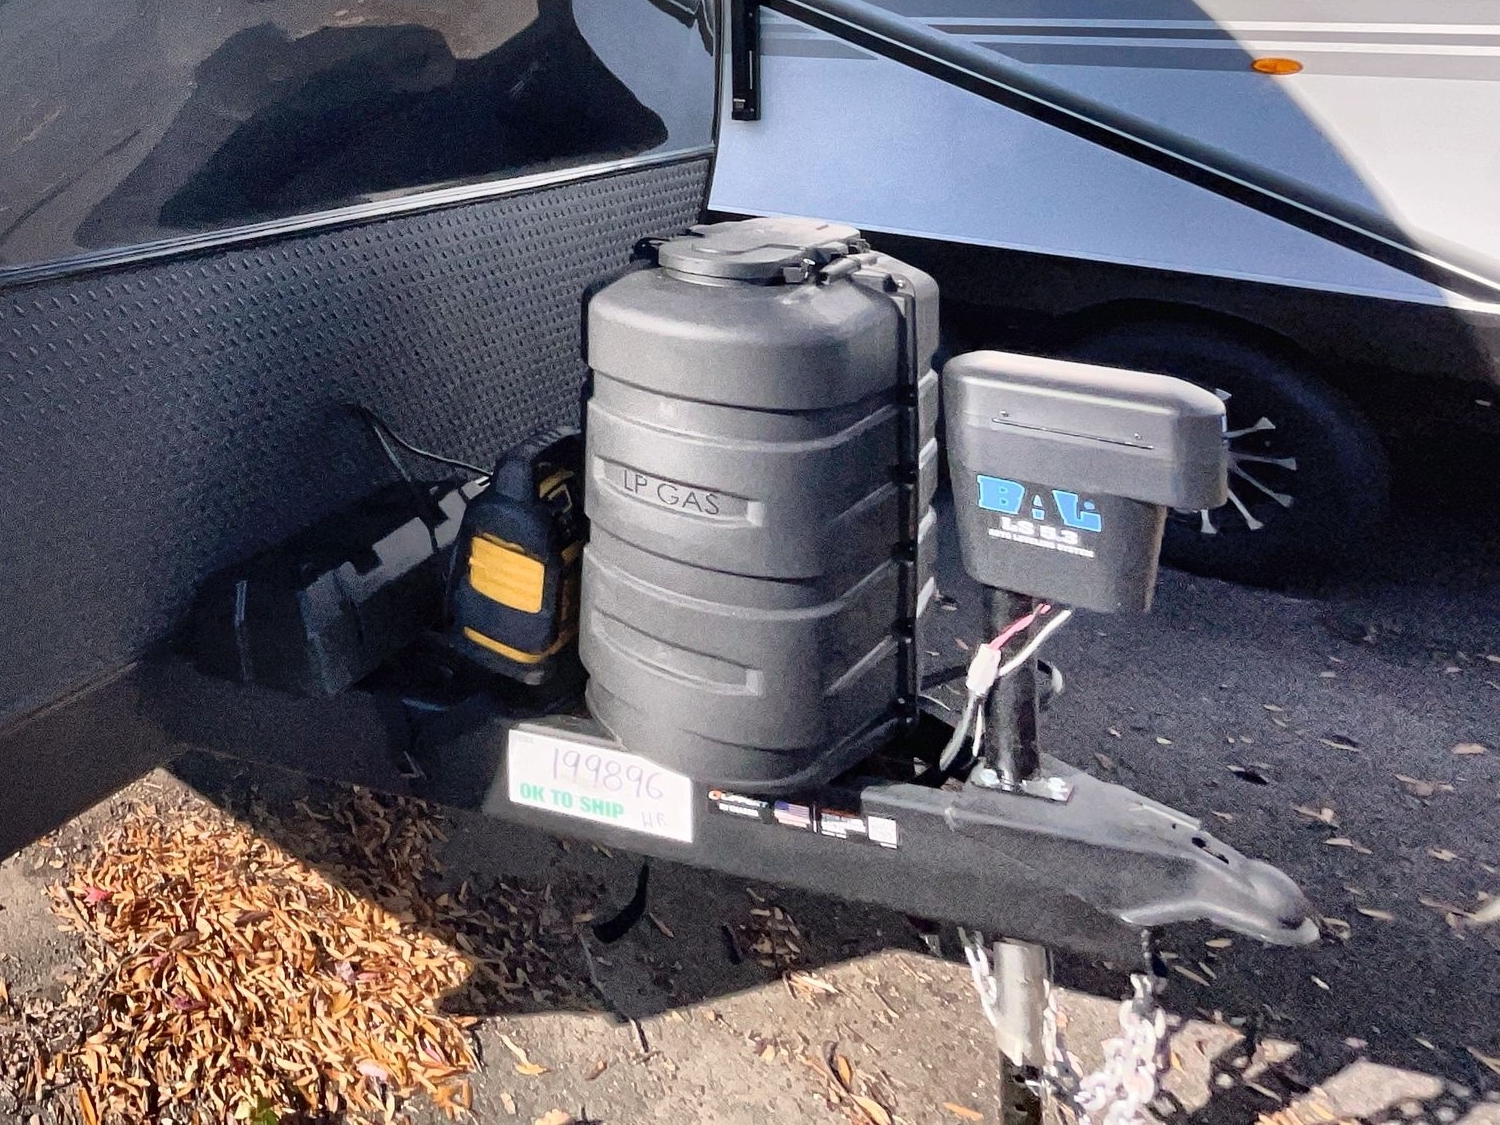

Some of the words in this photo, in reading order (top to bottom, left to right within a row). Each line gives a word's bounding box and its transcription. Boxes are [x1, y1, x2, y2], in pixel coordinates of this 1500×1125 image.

[623, 469, 648, 494] LP
[657, 482, 720, 515] GAS
[976, 473, 1102, 533] BAL
[552, 747, 664, 800] 199896
[519, 782, 546, 802] OK
[550, 788, 574, 808] TO
[579, 795, 625, 819] SHIP
